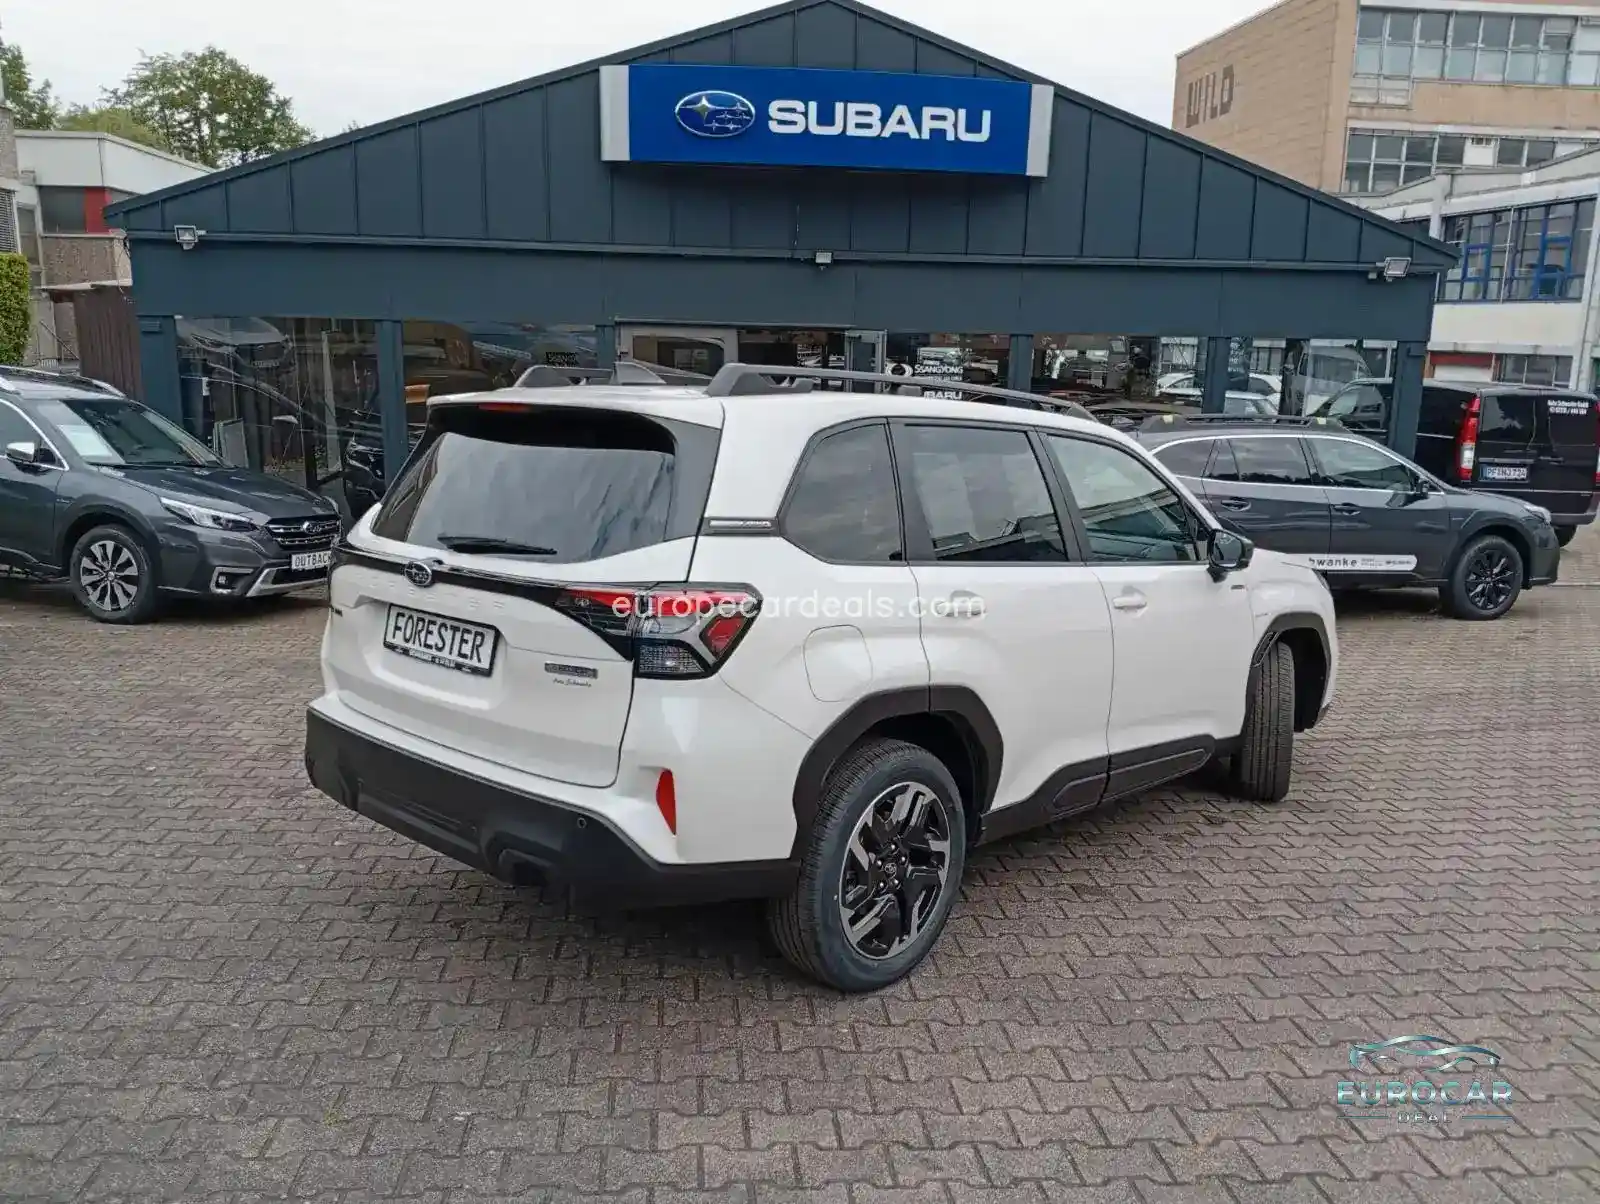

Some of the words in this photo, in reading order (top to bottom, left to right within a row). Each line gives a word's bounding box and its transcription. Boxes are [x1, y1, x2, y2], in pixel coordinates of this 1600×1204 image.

[1186, 64, 1234, 128] WILD
[768, 99, 991, 143] SUBARU
[915, 365, 963, 374] SSANGYONG
[924, 391, 963, 400] BARU
[392, 611, 486, 664] FORESTER
